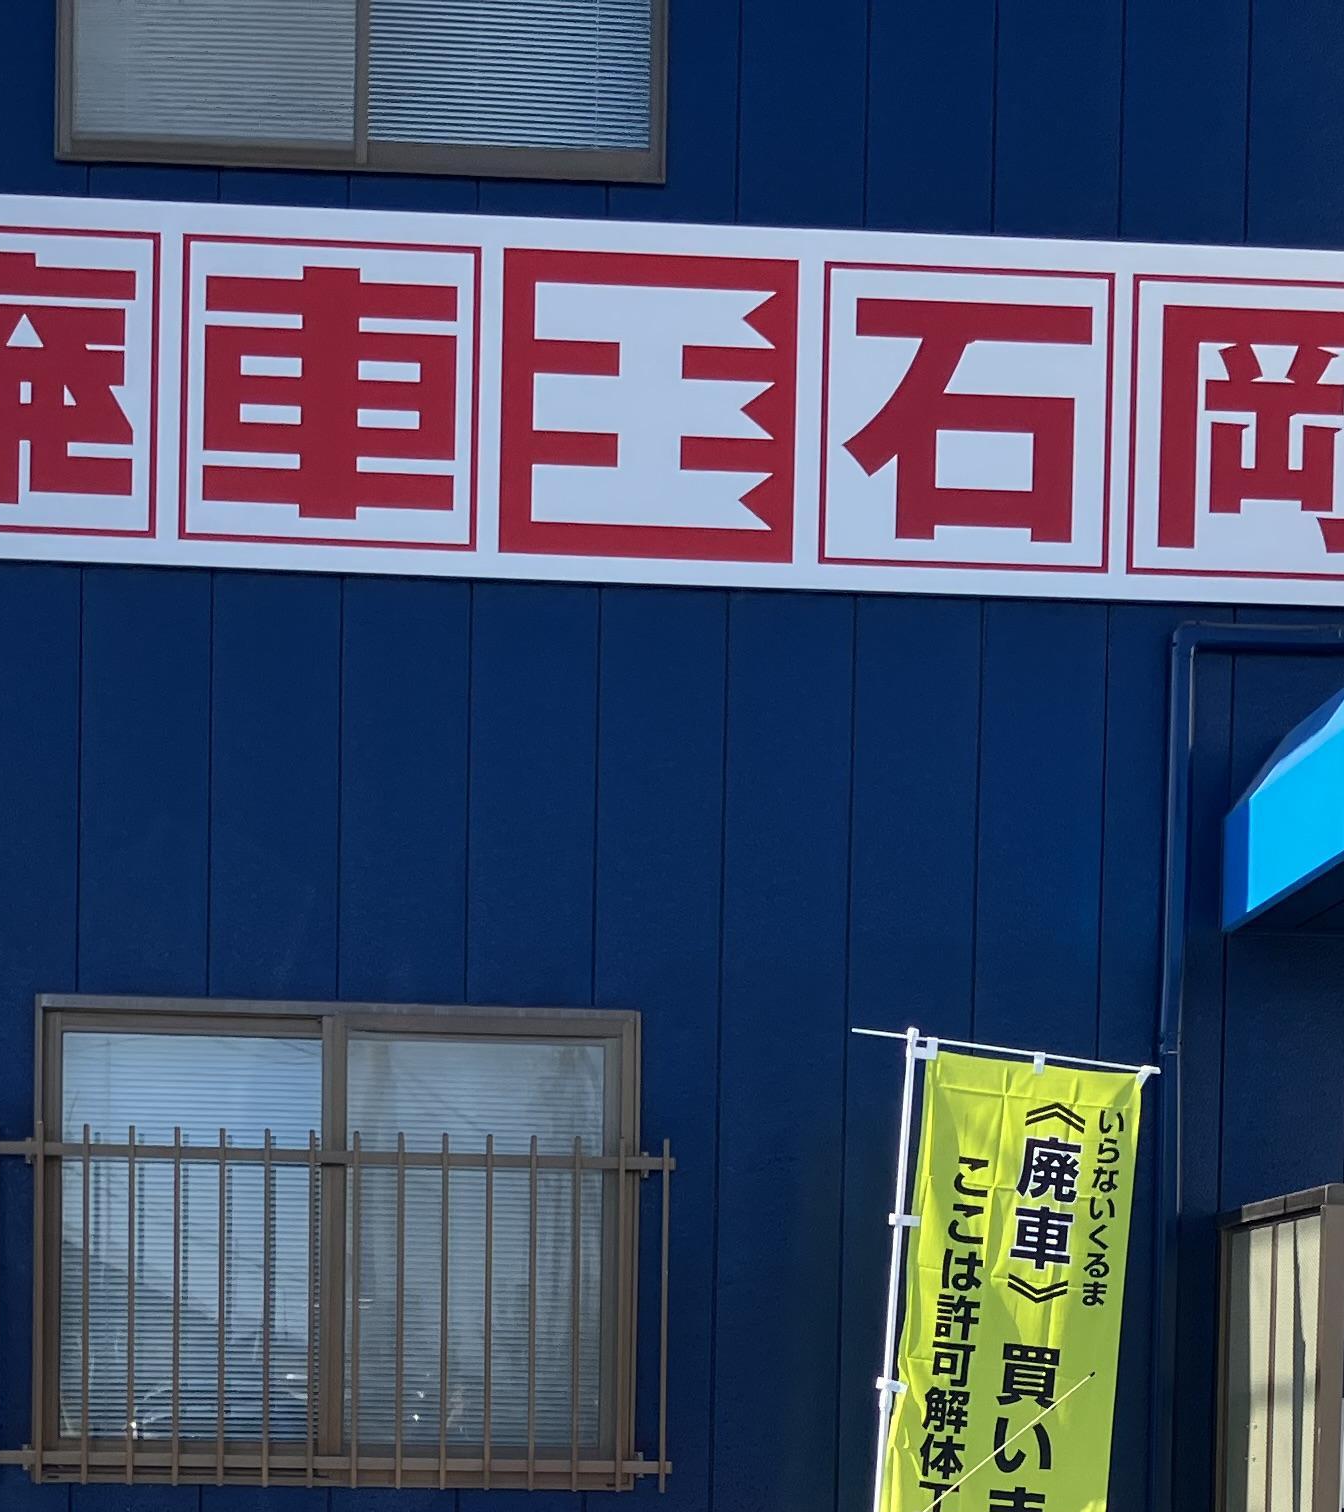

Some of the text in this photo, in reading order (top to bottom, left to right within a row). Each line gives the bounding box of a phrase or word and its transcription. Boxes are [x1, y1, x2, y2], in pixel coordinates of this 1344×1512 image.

[1082, 1109, 1124, 1306] いらないくるま
